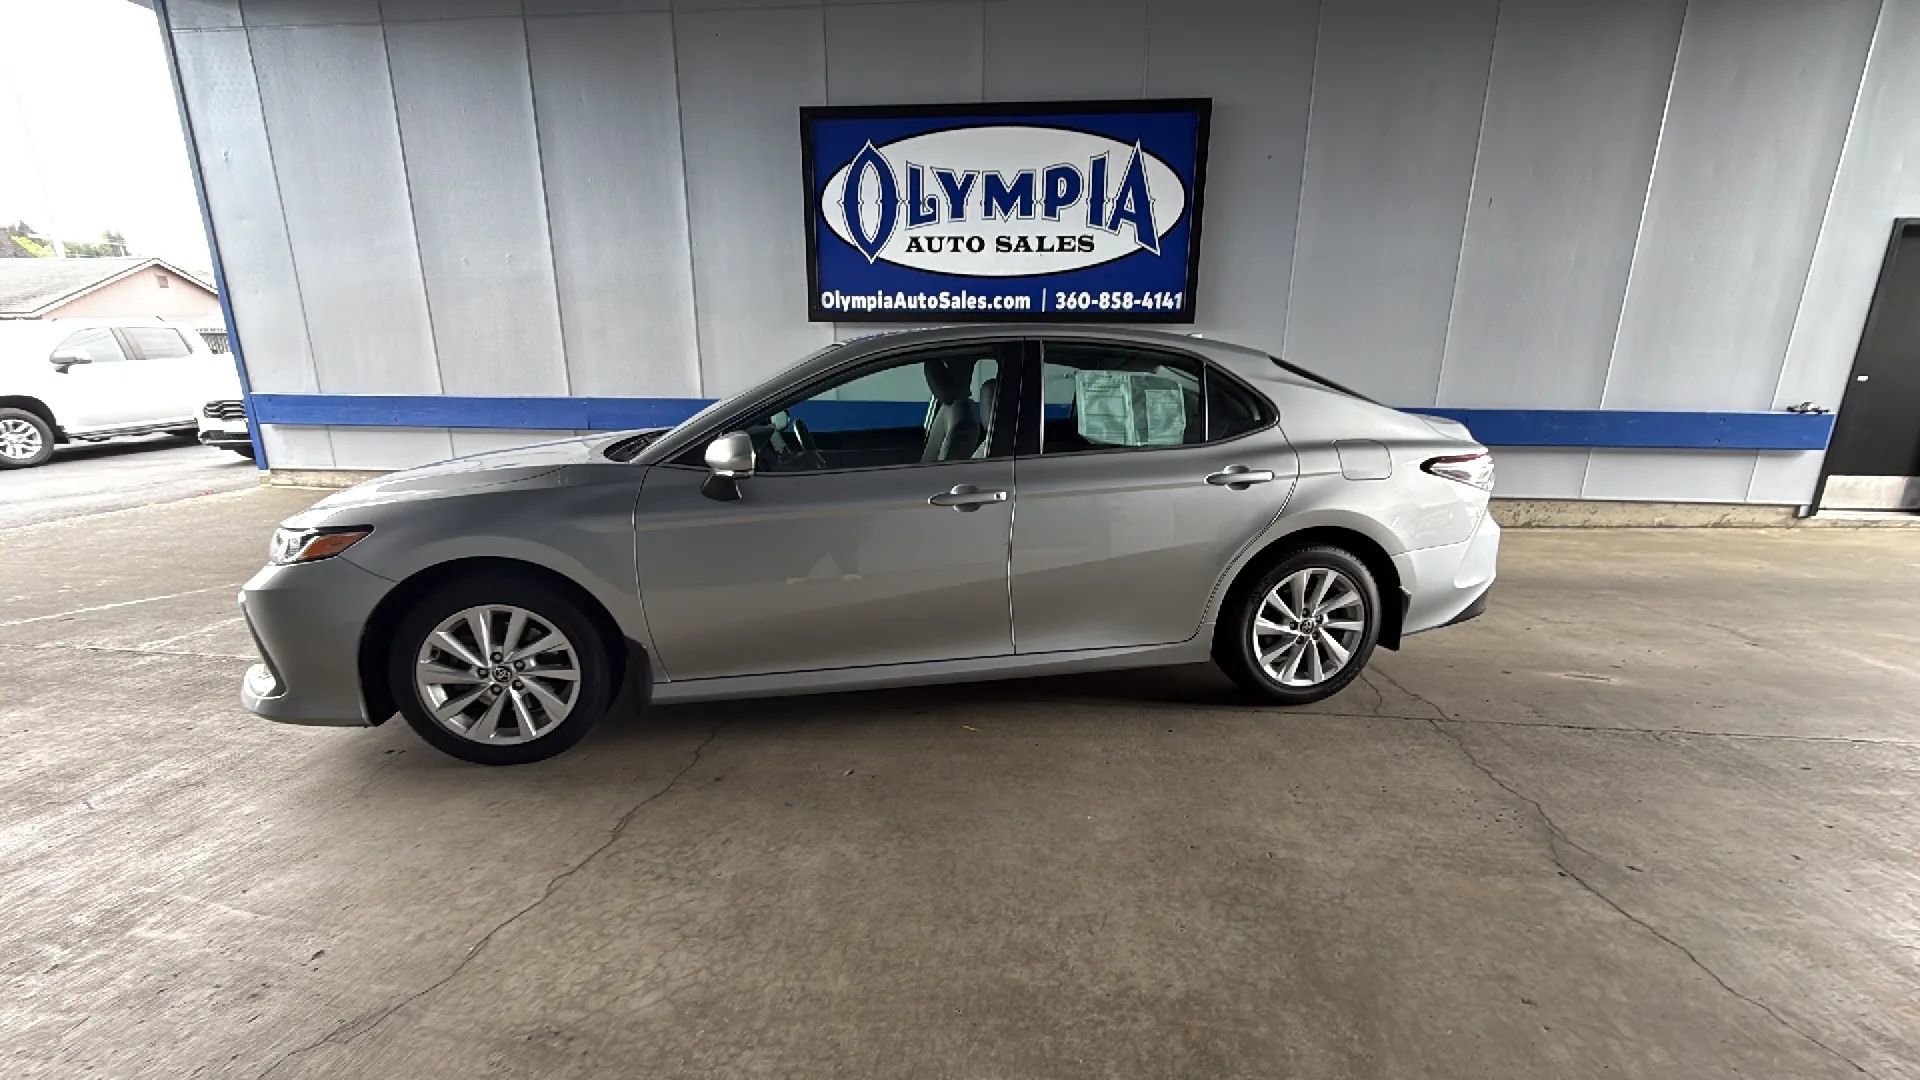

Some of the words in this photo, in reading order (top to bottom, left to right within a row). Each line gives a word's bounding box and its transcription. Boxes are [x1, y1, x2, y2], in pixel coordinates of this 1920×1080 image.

[837, 139, 1160, 264] OLYMPIA
[905, 235, 985, 253] AUTO
[995, 235, 1095, 254] SALES
[821, 289, 1031, 313] OlympiaAutoSales.com
[1055, 291, 1183, 310] 360-858-4141
